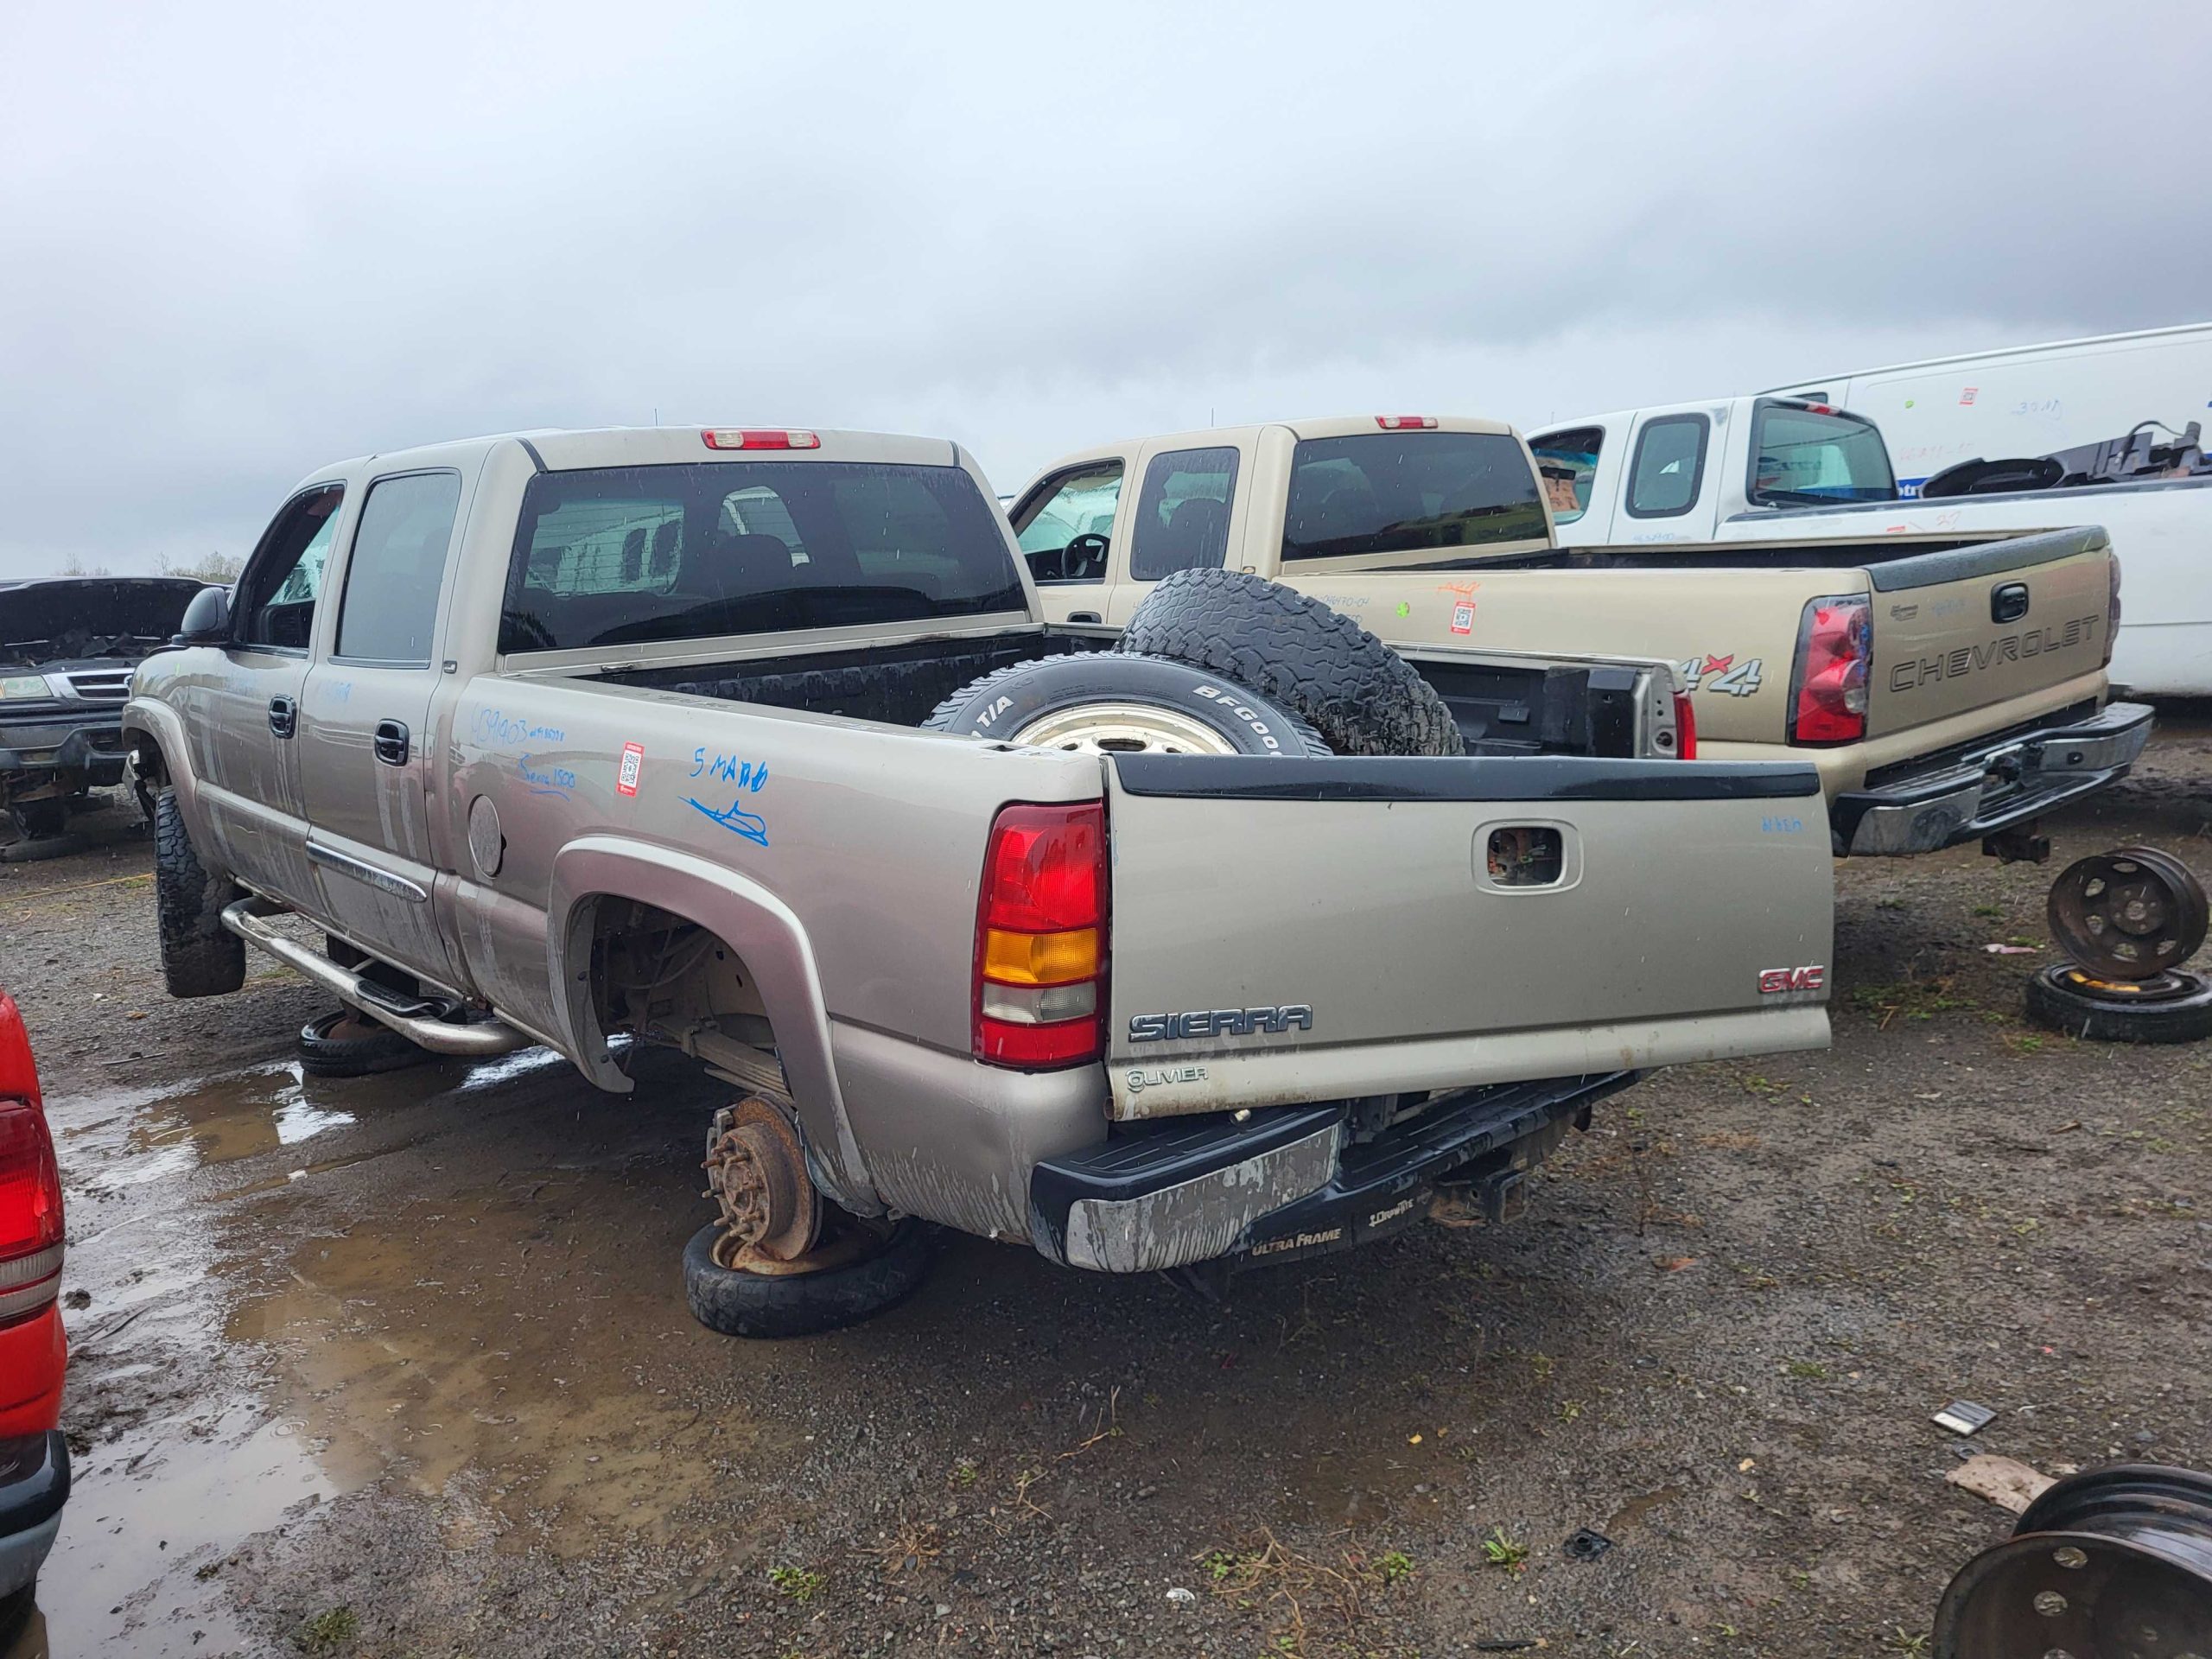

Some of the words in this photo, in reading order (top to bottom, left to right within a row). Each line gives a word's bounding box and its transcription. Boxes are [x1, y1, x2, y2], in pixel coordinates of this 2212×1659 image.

[1890, 614, 2100, 692] CHEVROLET
[976, 696, 1015, 728] T/A
[1758, 965, 1824, 993] GMC
[1128, 1004, 1313, 1042] SIERRA
[1127, 1066, 1209, 1092] OLIVIER
[1253, 1238, 1294, 1256] ULTRA
[1295, 1228, 1342, 1248] FRAME
